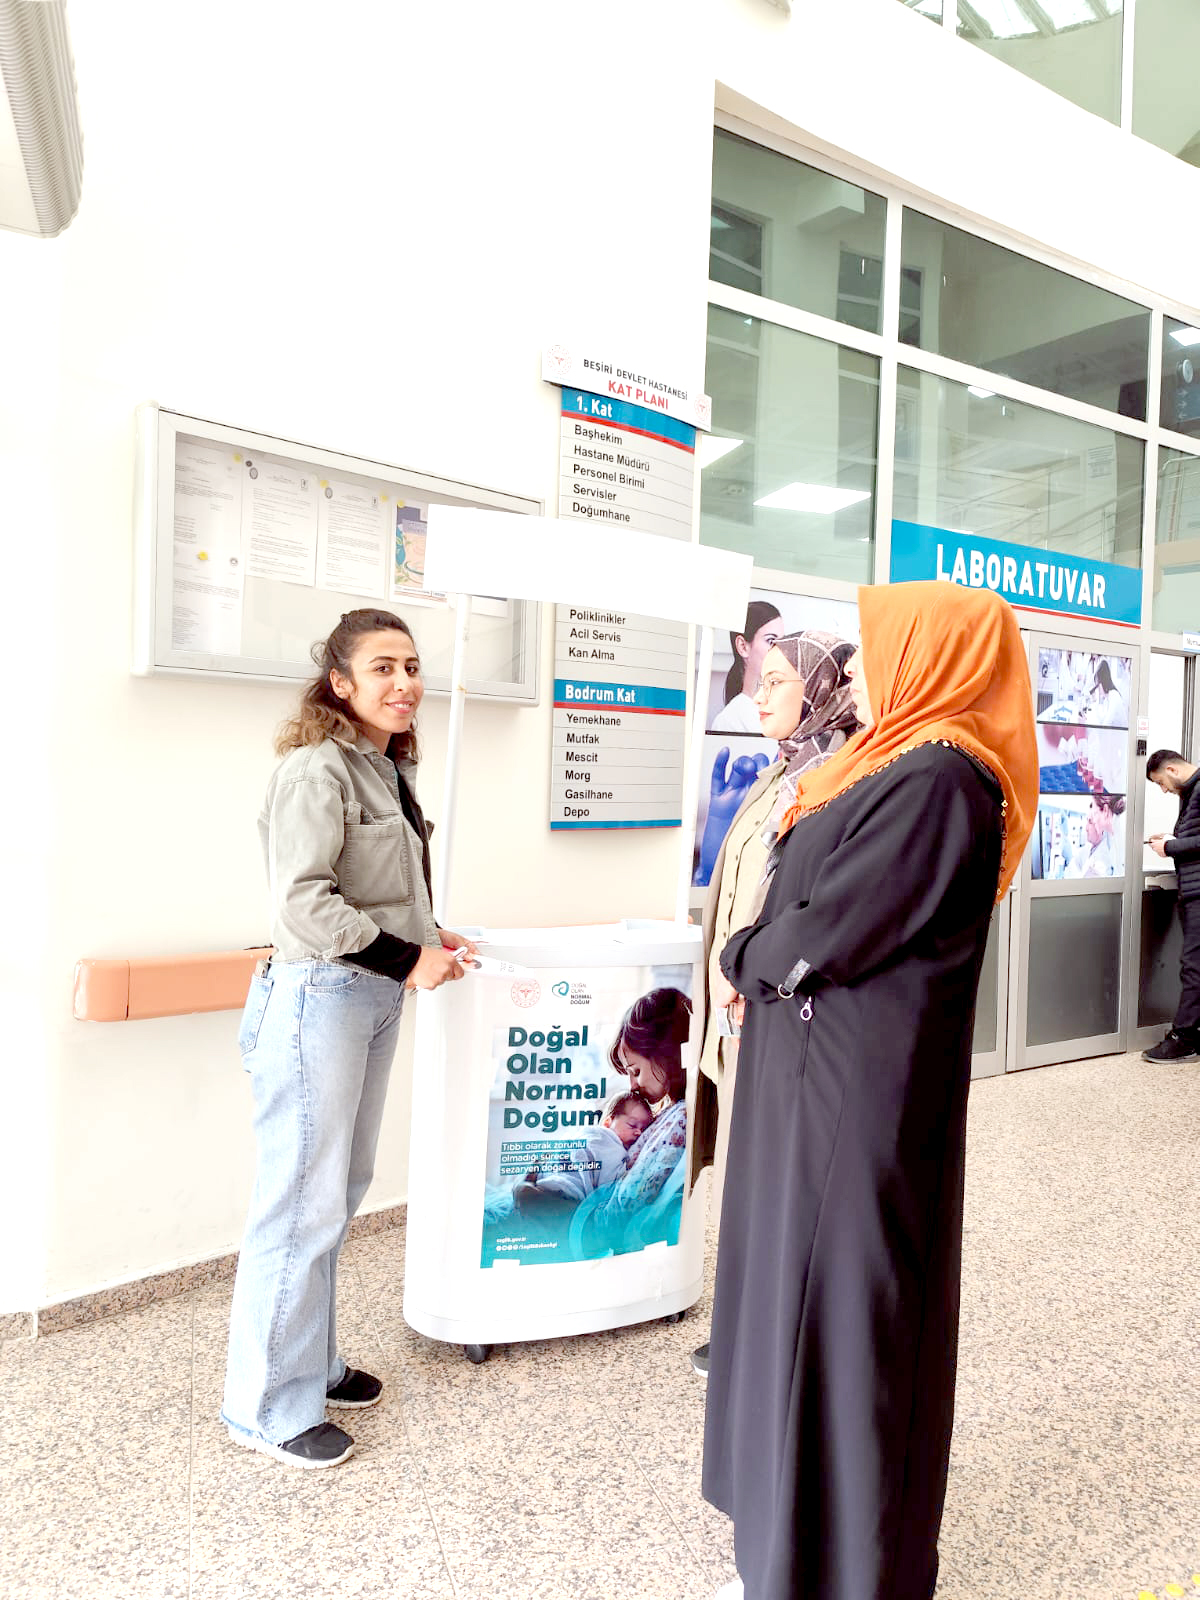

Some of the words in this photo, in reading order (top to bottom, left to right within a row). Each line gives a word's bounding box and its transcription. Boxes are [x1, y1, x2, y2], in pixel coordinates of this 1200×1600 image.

[583, 359, 612, 375] BEŞİRİ
[616, 369, 646, 385] DEVLET
[649, 379, 688, 400] HASTANESİ
[608, 380, 632, 398] KAT
[636, 388, 668, 410] PLANI
[577, 395, 588, 412] 1.
[591, 399, 612, 418] Kat
[575, 424, 622, 445] Başhekim
[574, 444, 614, 463] Hastane
[617, 454, 650, 471] Müdürü
[573, 463, 617, 482] Personel
[619, 473, 645, 488] Birimi
[573, 483, 617, 501] Servisler
[572, 502, 630, 522] Doğumhane
[936, 543, 1106, 609] LABORATUVAR
[570, 609, 626, 624] Poliklinikler
[570, 628, 589, 639] Acil
[592, 629, 621, 643] Servis
[568, 646, 588, 658] Kan
[591, 649, 615, 660] Alma
[565, 684, 614, 702] Bodrum
[616, 687, 636, 703] Kat
[566, 713, 621, 726] Yemekhane
[566, 733, 600, 744] Mutfak
[566, 752, 598, 762] Mescit
[565, 770, 591, 783] Morg
[565, 789, 613, 800] Gasilhane
[563, 806, 590, 819] Depo
[508, 1025, 589, 1053] Doğal
[507, 1053, 572, 1074] Olan
[505, 1078, 606, 1101] Normal
[503, 1105, 604, 1133] Doğum
[525, 1142, 552, 1150] olarak
[553, 1140, 586, 1149] zorunlu
[540, 1151, 570, 1160] sürece
[500, 1165, 540, 1174] sezaryen
[541, 1163, 566, 1173] doğal
[567, 1160, 601, 1172] değildir.
